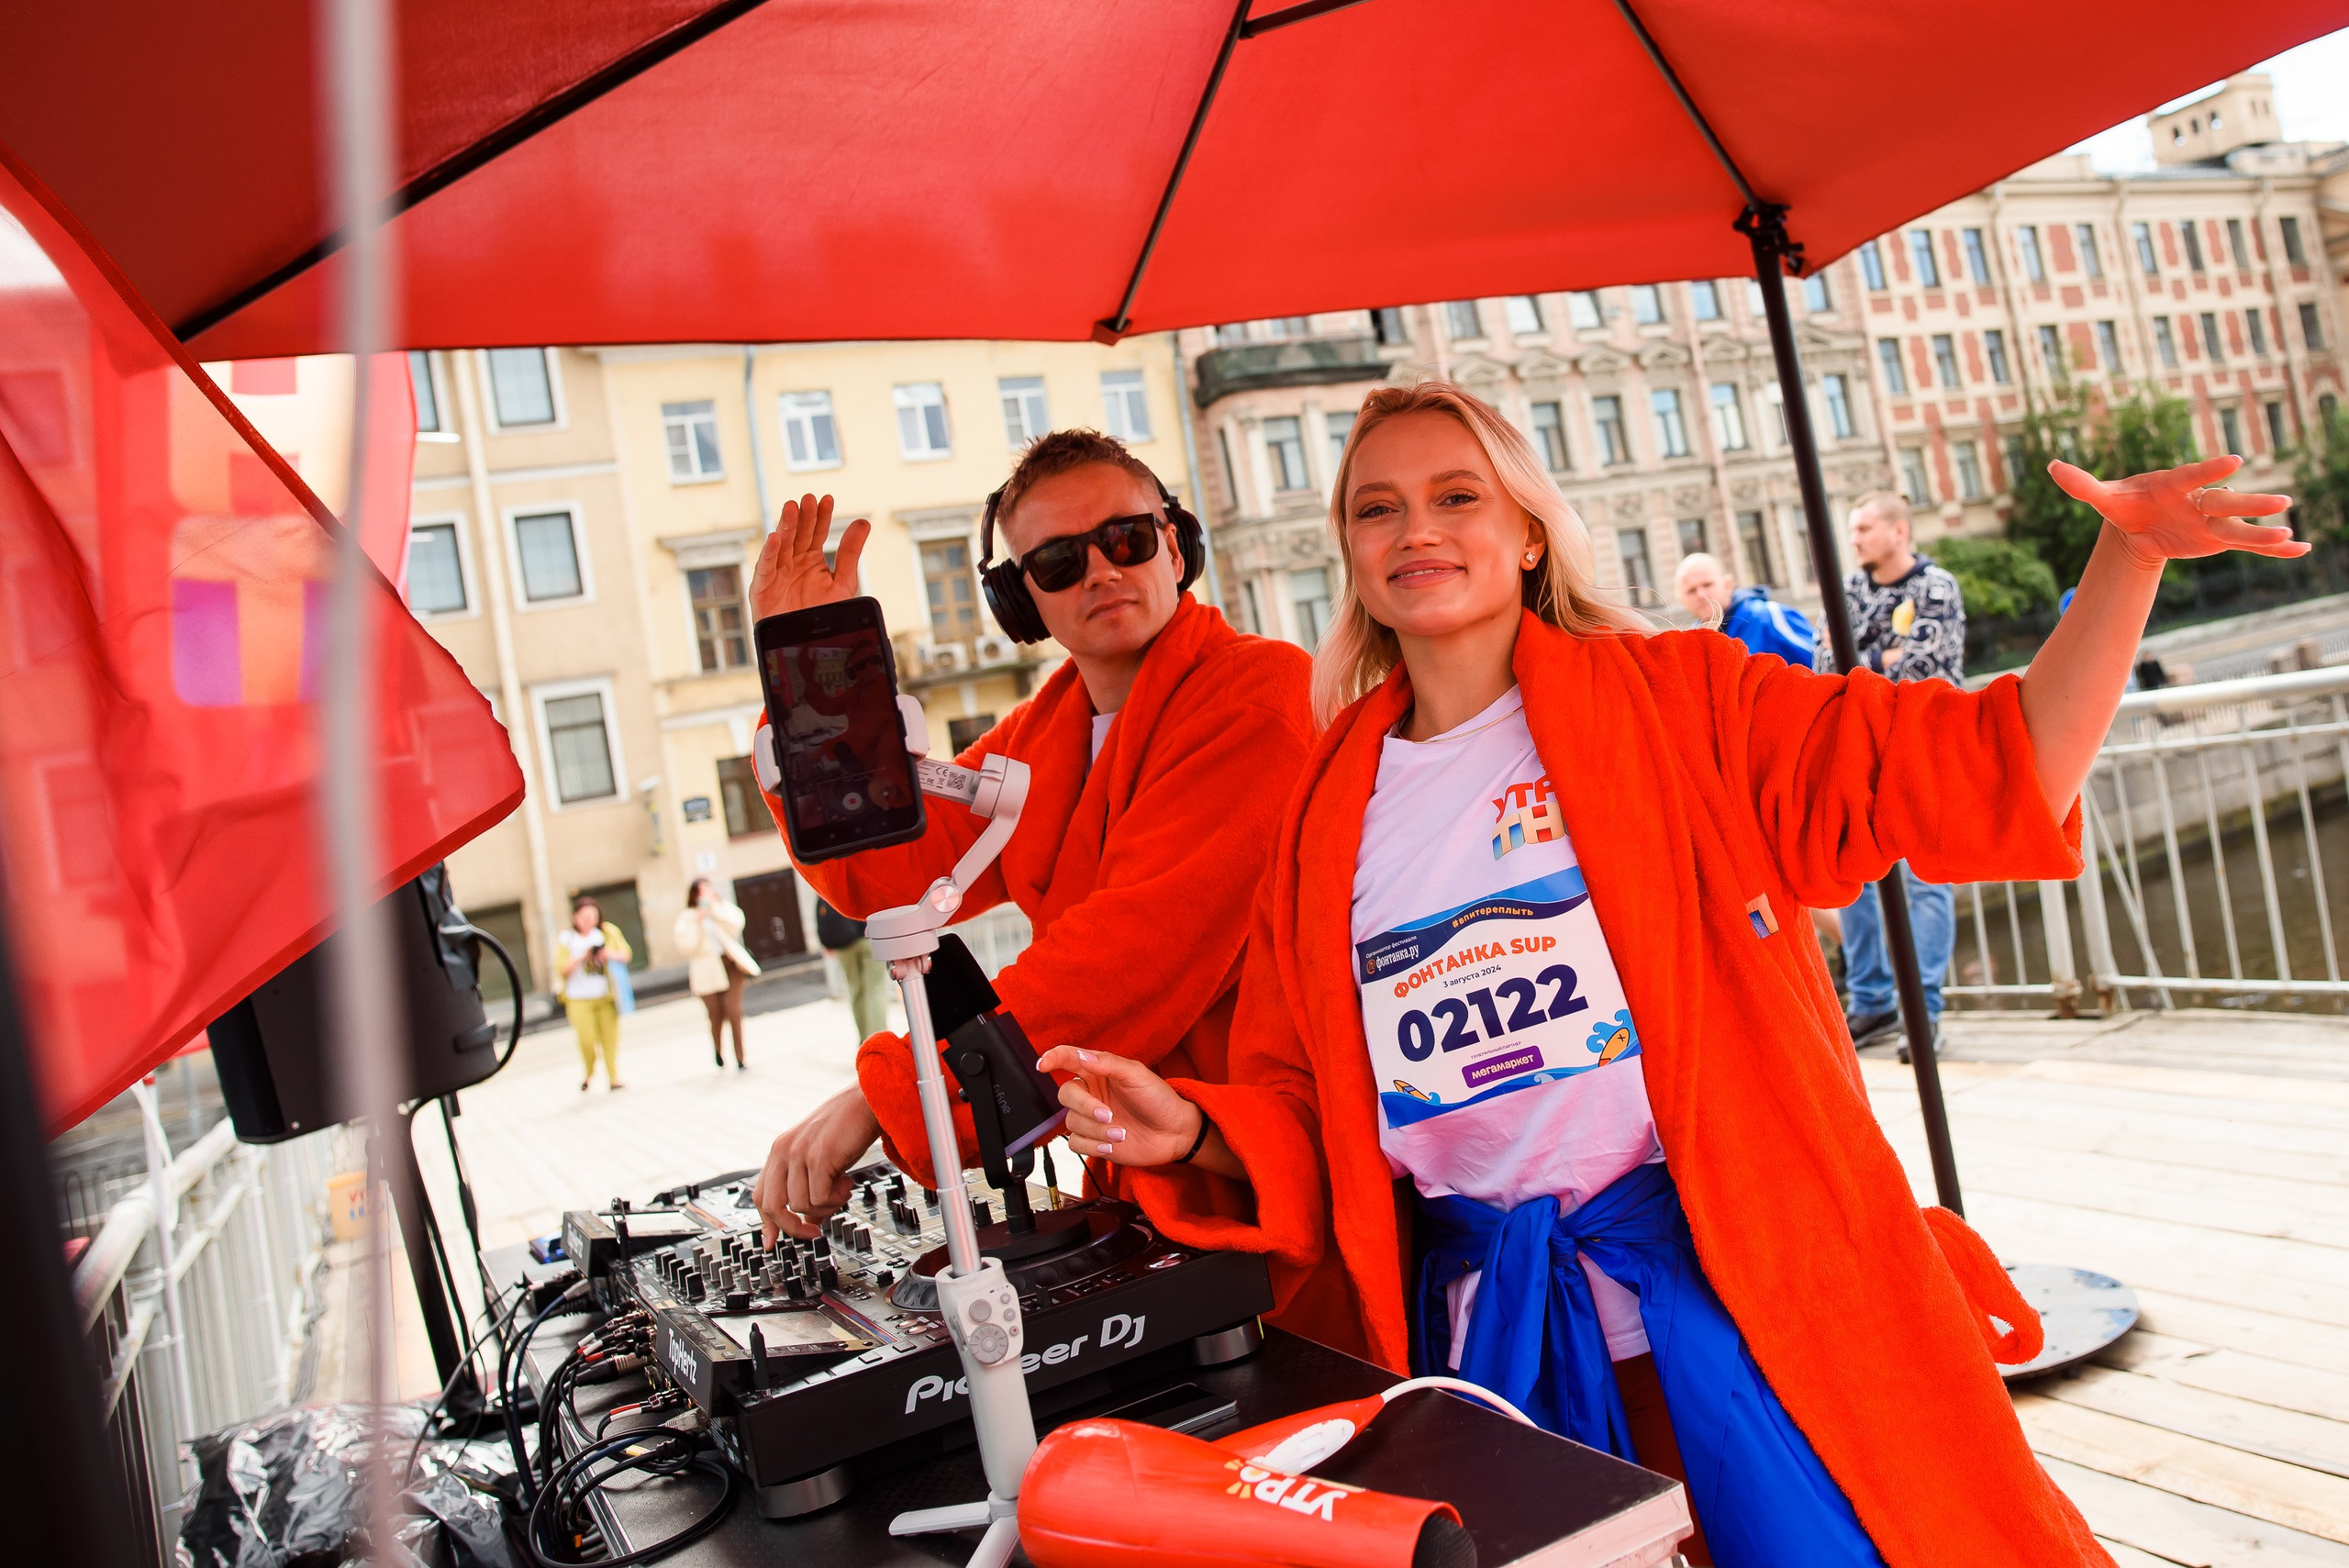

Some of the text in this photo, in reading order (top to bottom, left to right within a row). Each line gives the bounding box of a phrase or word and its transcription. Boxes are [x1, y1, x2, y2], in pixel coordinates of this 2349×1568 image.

[1492, 774, 1555, 824] УТР
[1491, 802, 1570, 861] ТН
[1452, 906, 1533, 928] #впитереплыть
[1394, 936, 1557, 998] ФОНТАНКА SUP
[1450, 972, 1480, 986] августа
[1481, 964, 1502, 976] 2024
[1397, 963, 1589, 1062] 02122
[1471, 1054, 1534, 1080] мегамаркет
[668, 1327, 697, 1385] TopHertz
[905, 1334, 1089, 1415] Pieer
